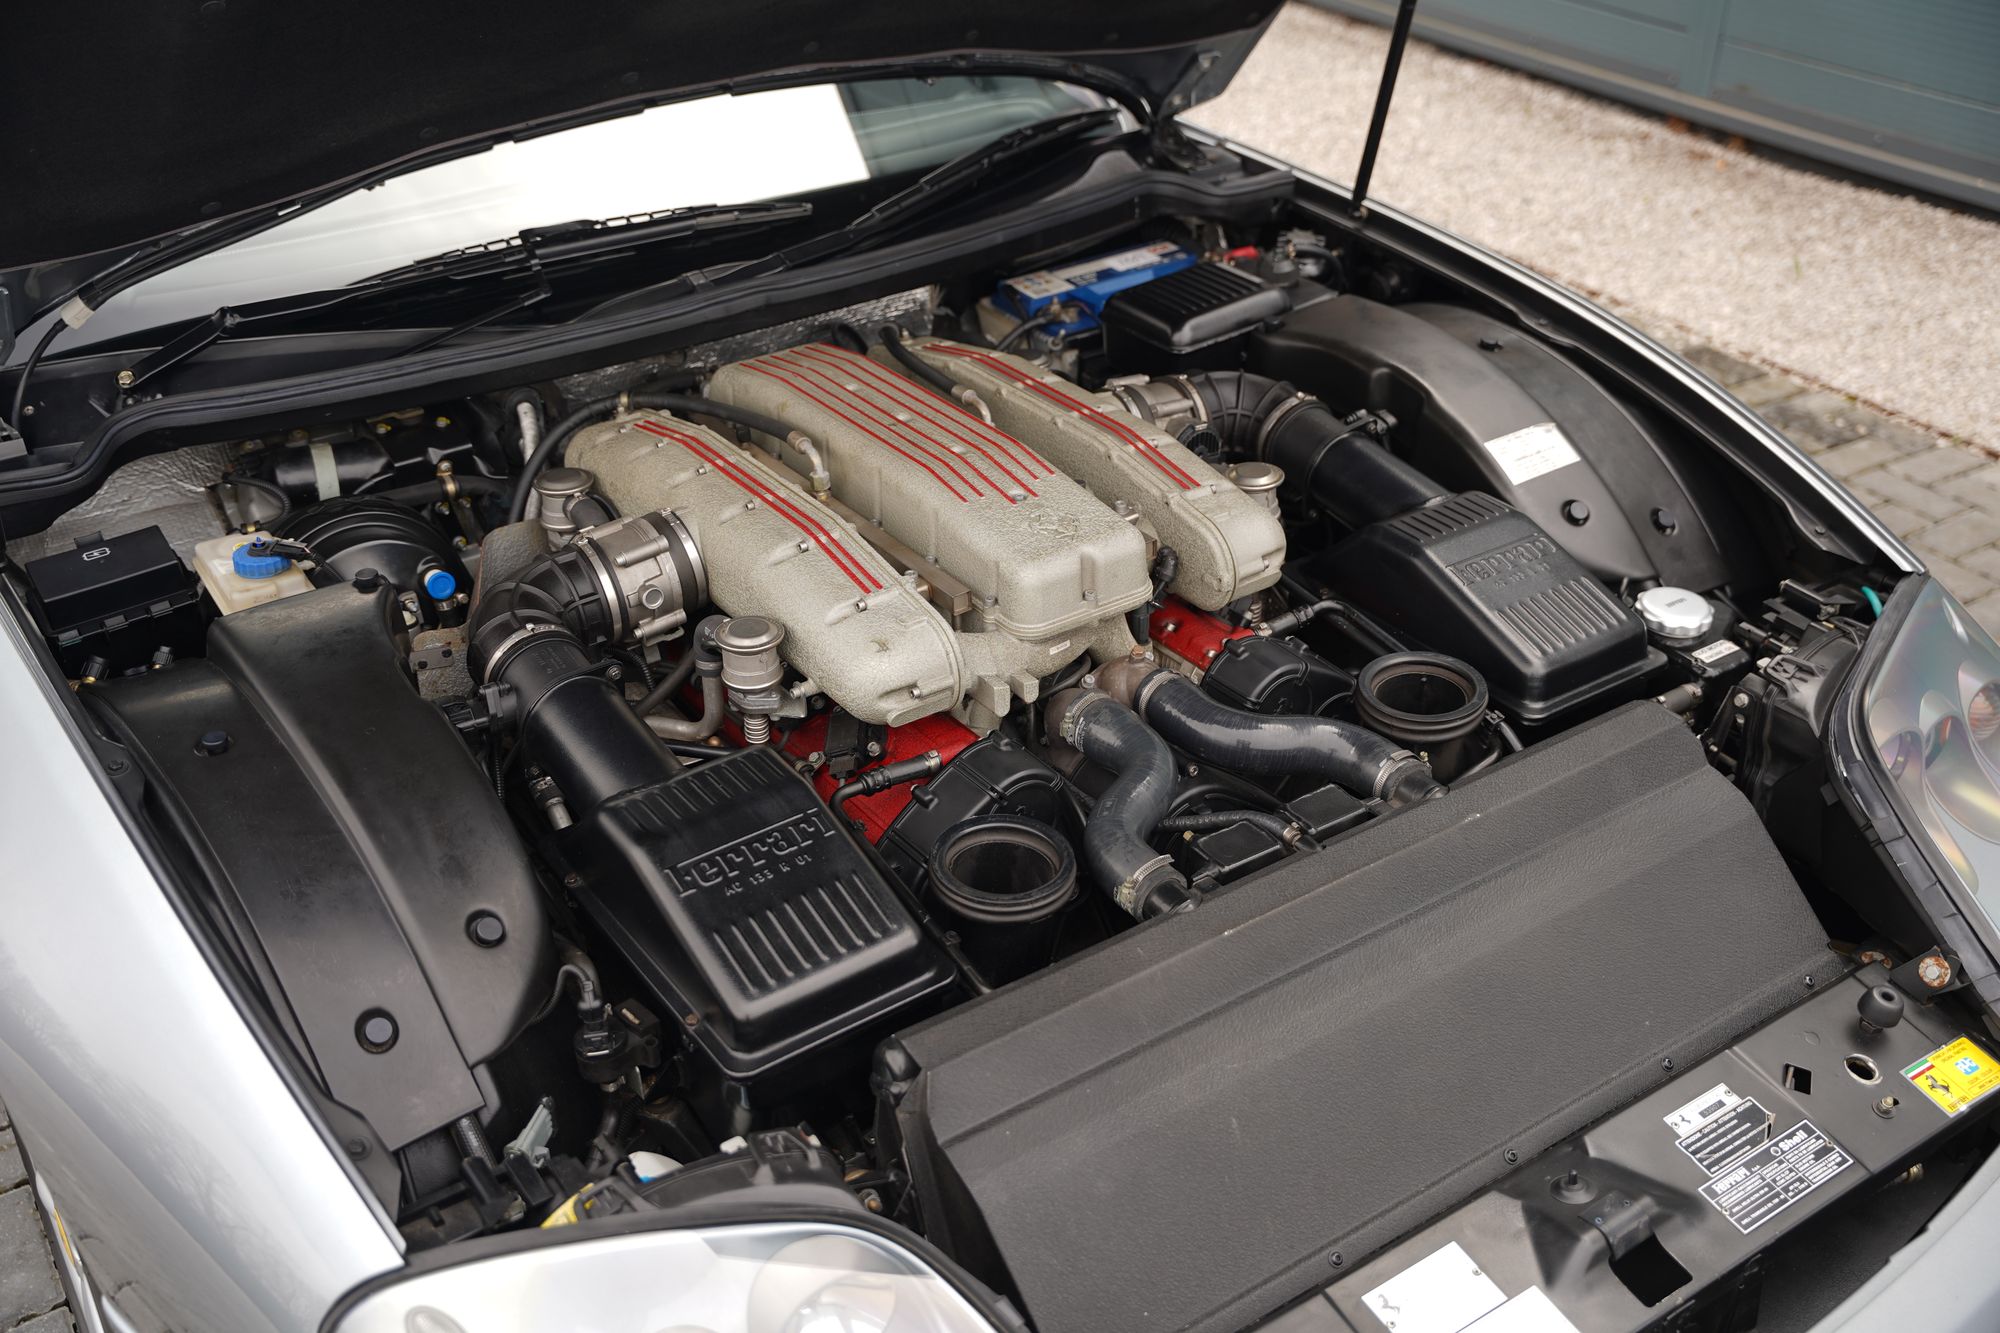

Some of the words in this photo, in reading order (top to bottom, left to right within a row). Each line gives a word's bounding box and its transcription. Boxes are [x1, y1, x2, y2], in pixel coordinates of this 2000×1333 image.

[1445, 533, 1556, 586] Ferrari
[664, 808, 836, 897] Ferrari
[1779, 1129, 1808, 1151] Shell
[1711, 1166, 1751, 1194] Ferrari
